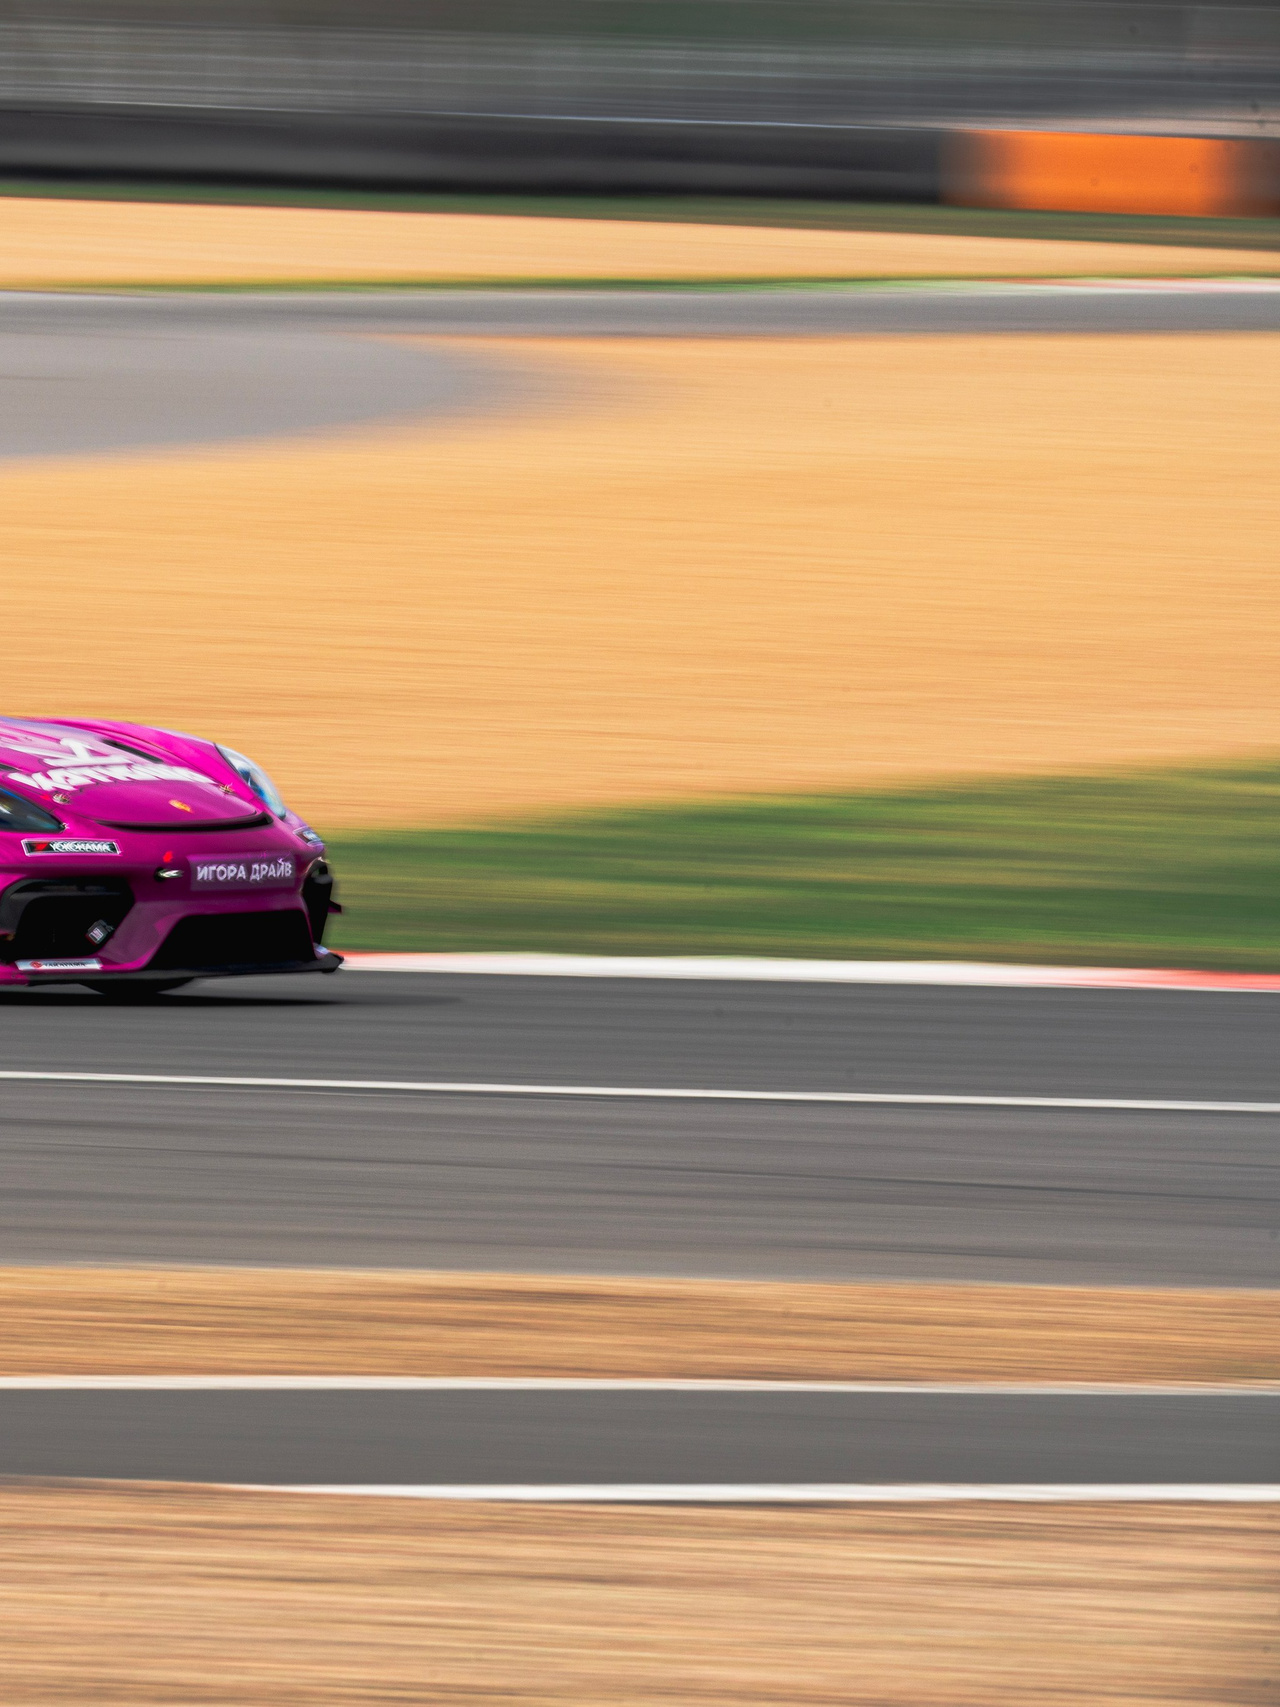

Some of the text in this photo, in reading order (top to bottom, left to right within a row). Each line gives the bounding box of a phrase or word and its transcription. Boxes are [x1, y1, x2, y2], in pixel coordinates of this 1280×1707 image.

[49, 841, 111, 853] YOKOHAMA
[196, 860, 292, 881] ИГОРА ДРАЙВ
